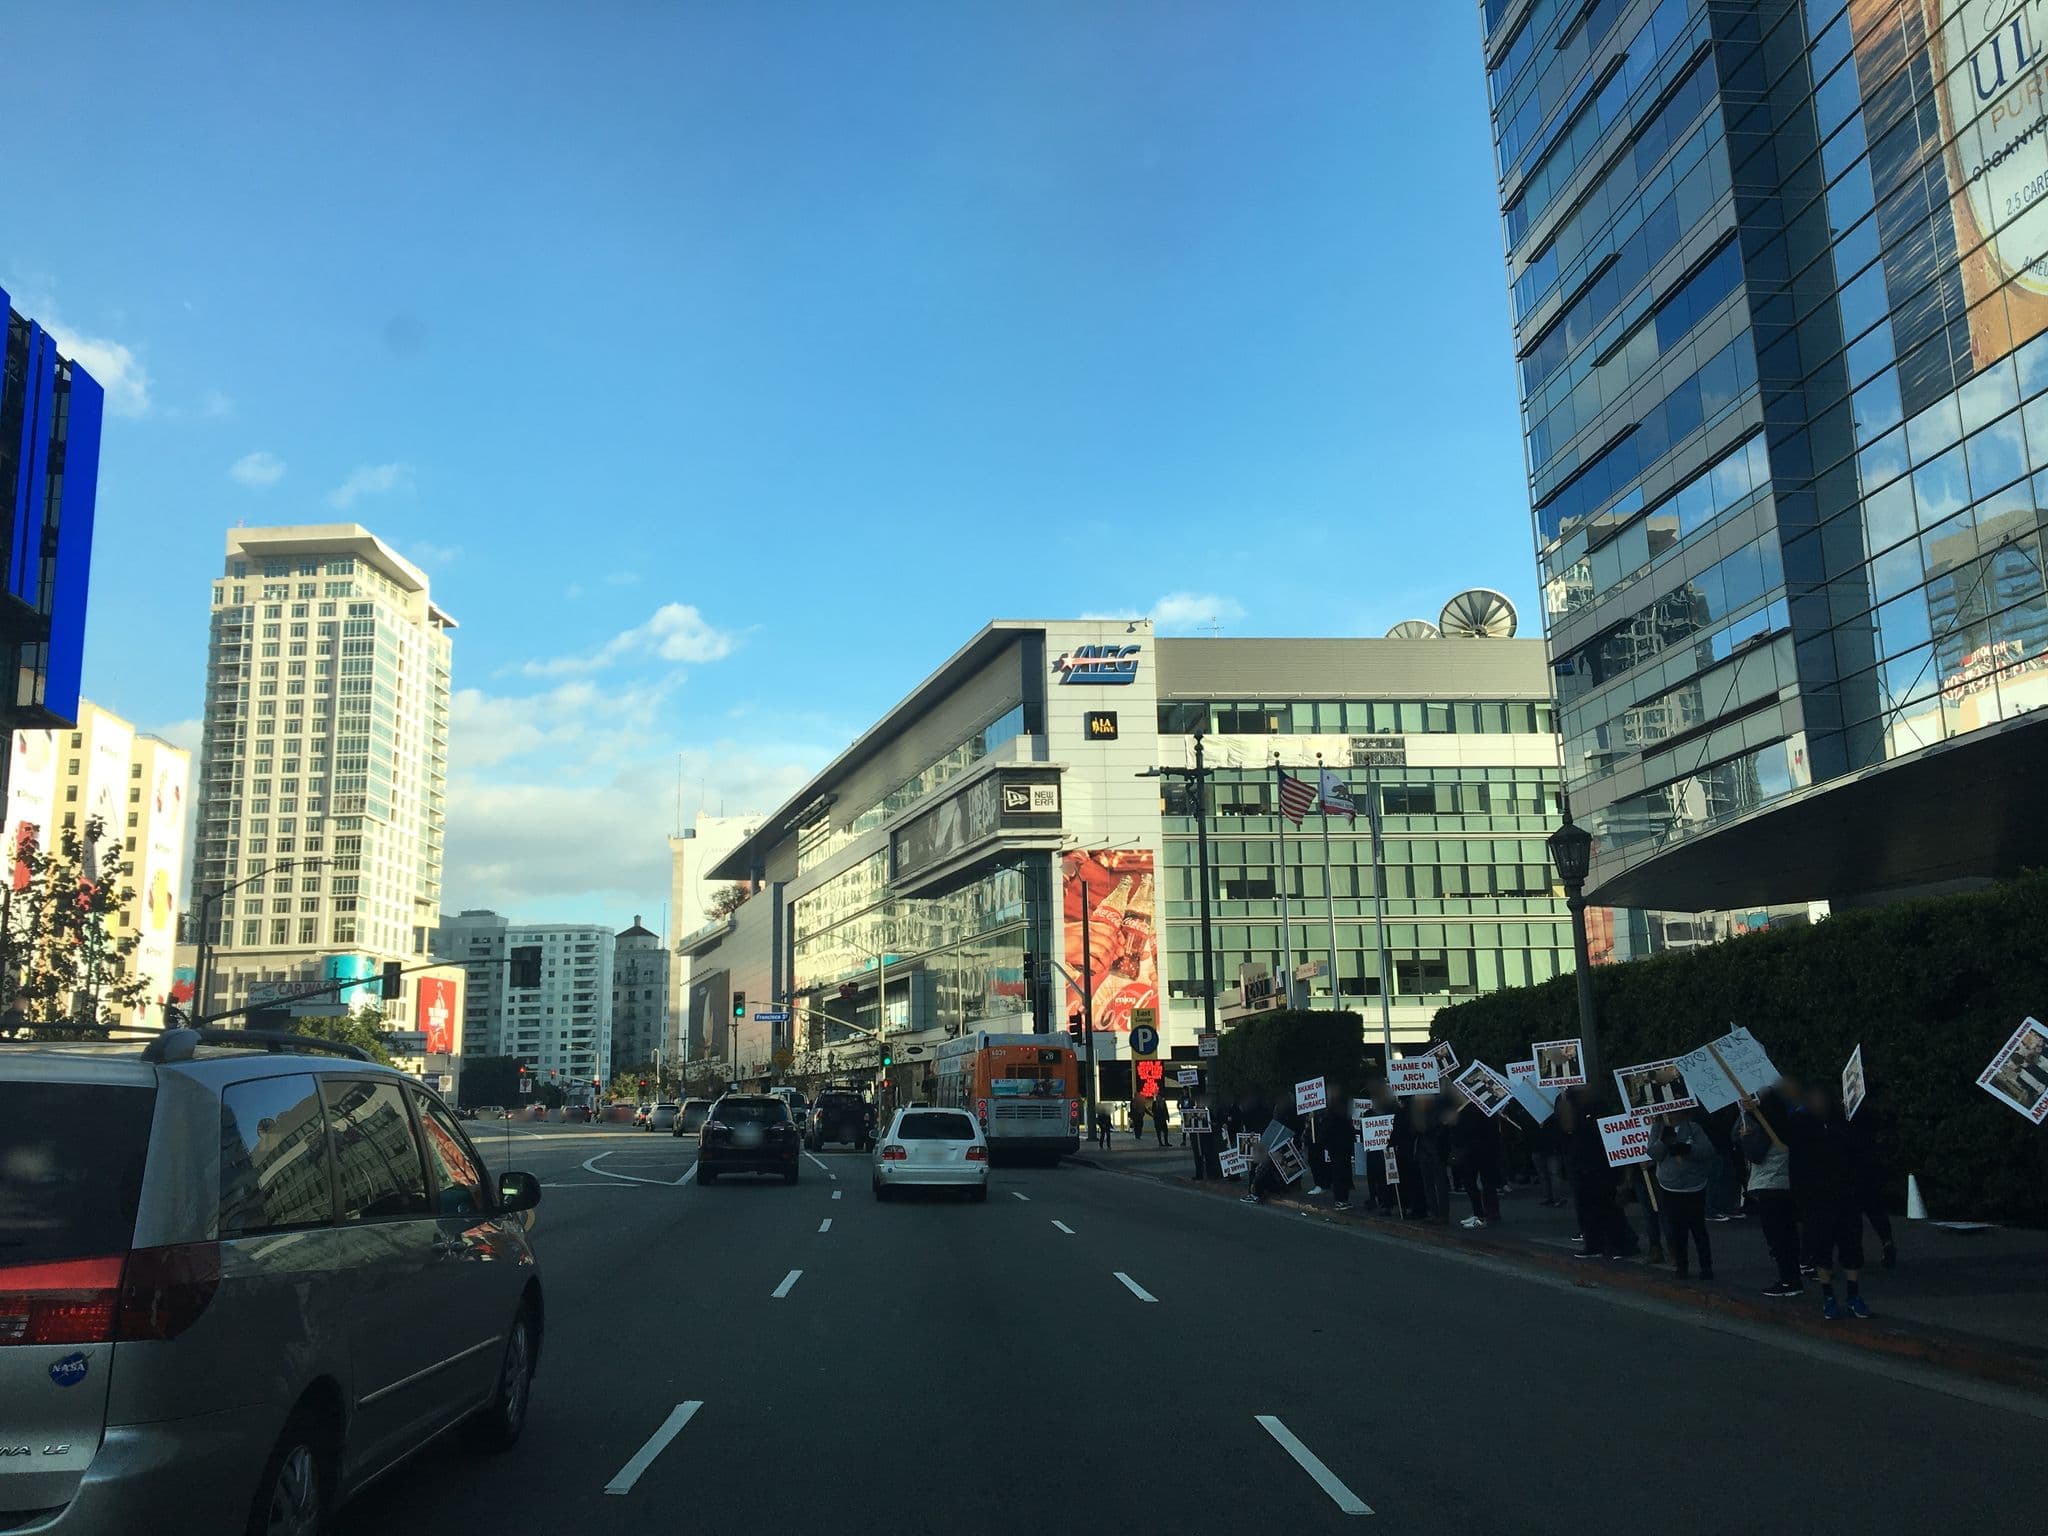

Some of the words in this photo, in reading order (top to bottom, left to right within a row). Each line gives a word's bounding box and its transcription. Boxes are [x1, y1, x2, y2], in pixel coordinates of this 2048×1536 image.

[1991, 66, 2048, 133] PUR
[2006, 191, 2021, 216] 2.5
[1066, 643, 1142, 684] AEG
[1034, 791, 1054, 799] NEW
[1034, 798, 1054, 806] ERA
[1115, 994, 1136, 1005] enjoy
[1391, 1062, 1420, 1072] SHAME
[1421, 1061, 1433, 1070] ON
[1403, 1072, 1425, 1082] ARCH
[1298, 1083, 1314, 1093] SHAME
[1314, 1081, 1323, 1089] ON
[1391, 1081, 1438, 1092] INSURANCE
[1304, 1092, 1318, 1100] ARCH
[1298, 1098, 1325, 1110] INSURANCE
[1631, 1107, 1650, 1117] ARCH
[1650, 1099, 1695, 1112] INSURANCE
[1365, 1119, 1389, 1128] SHAME
[1604, 1118, 1642, 1133] SHAME
[1621, 1131, 1649, 1146] ARCH
[52, 1362, 86, 1372] NASA
[43, 1444, 71, 1456] LE
